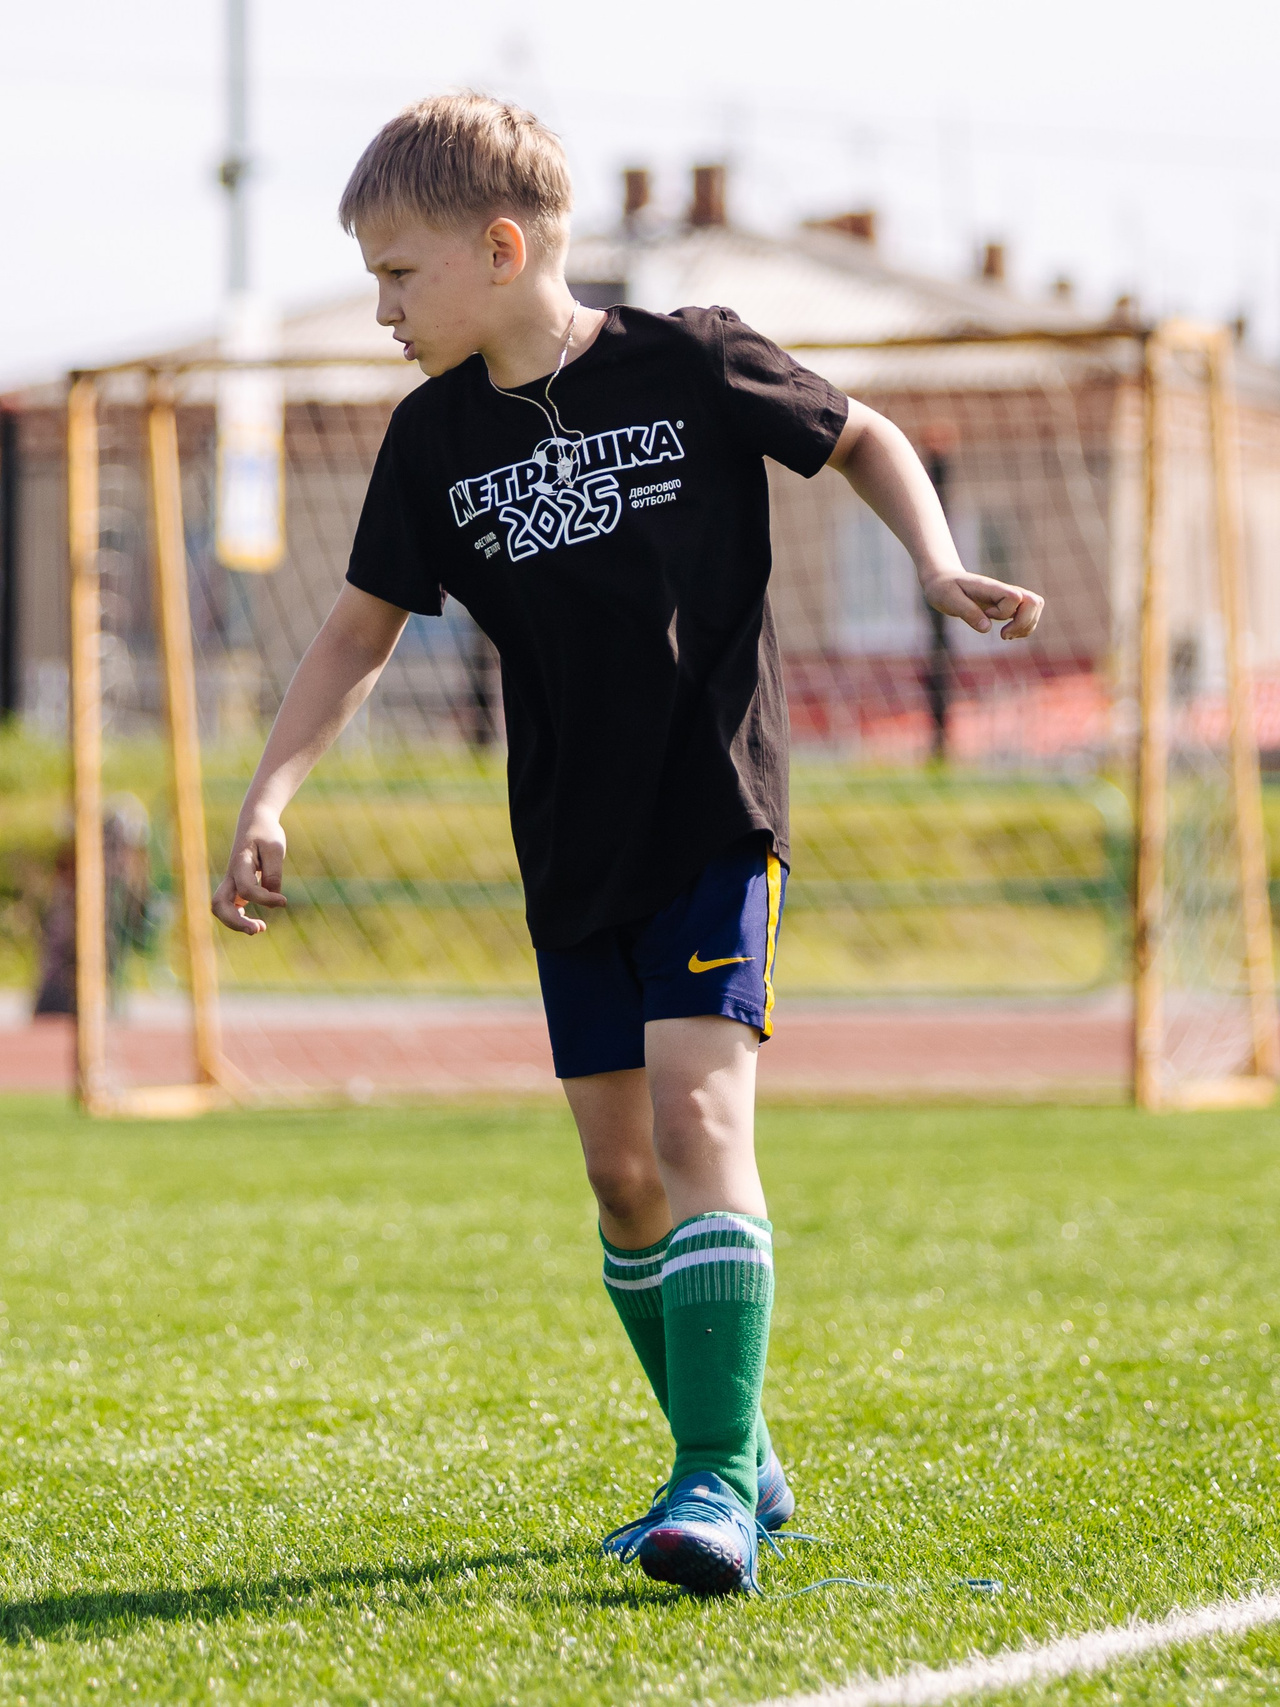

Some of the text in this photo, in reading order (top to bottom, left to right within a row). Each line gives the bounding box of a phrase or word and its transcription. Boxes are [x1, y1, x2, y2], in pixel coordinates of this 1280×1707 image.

[629, 479, 682, 499] ДВОРОВОГО
[631, 492, 677, 509] ФУТБОЛА
[499, 474, 622, 562] 2025
